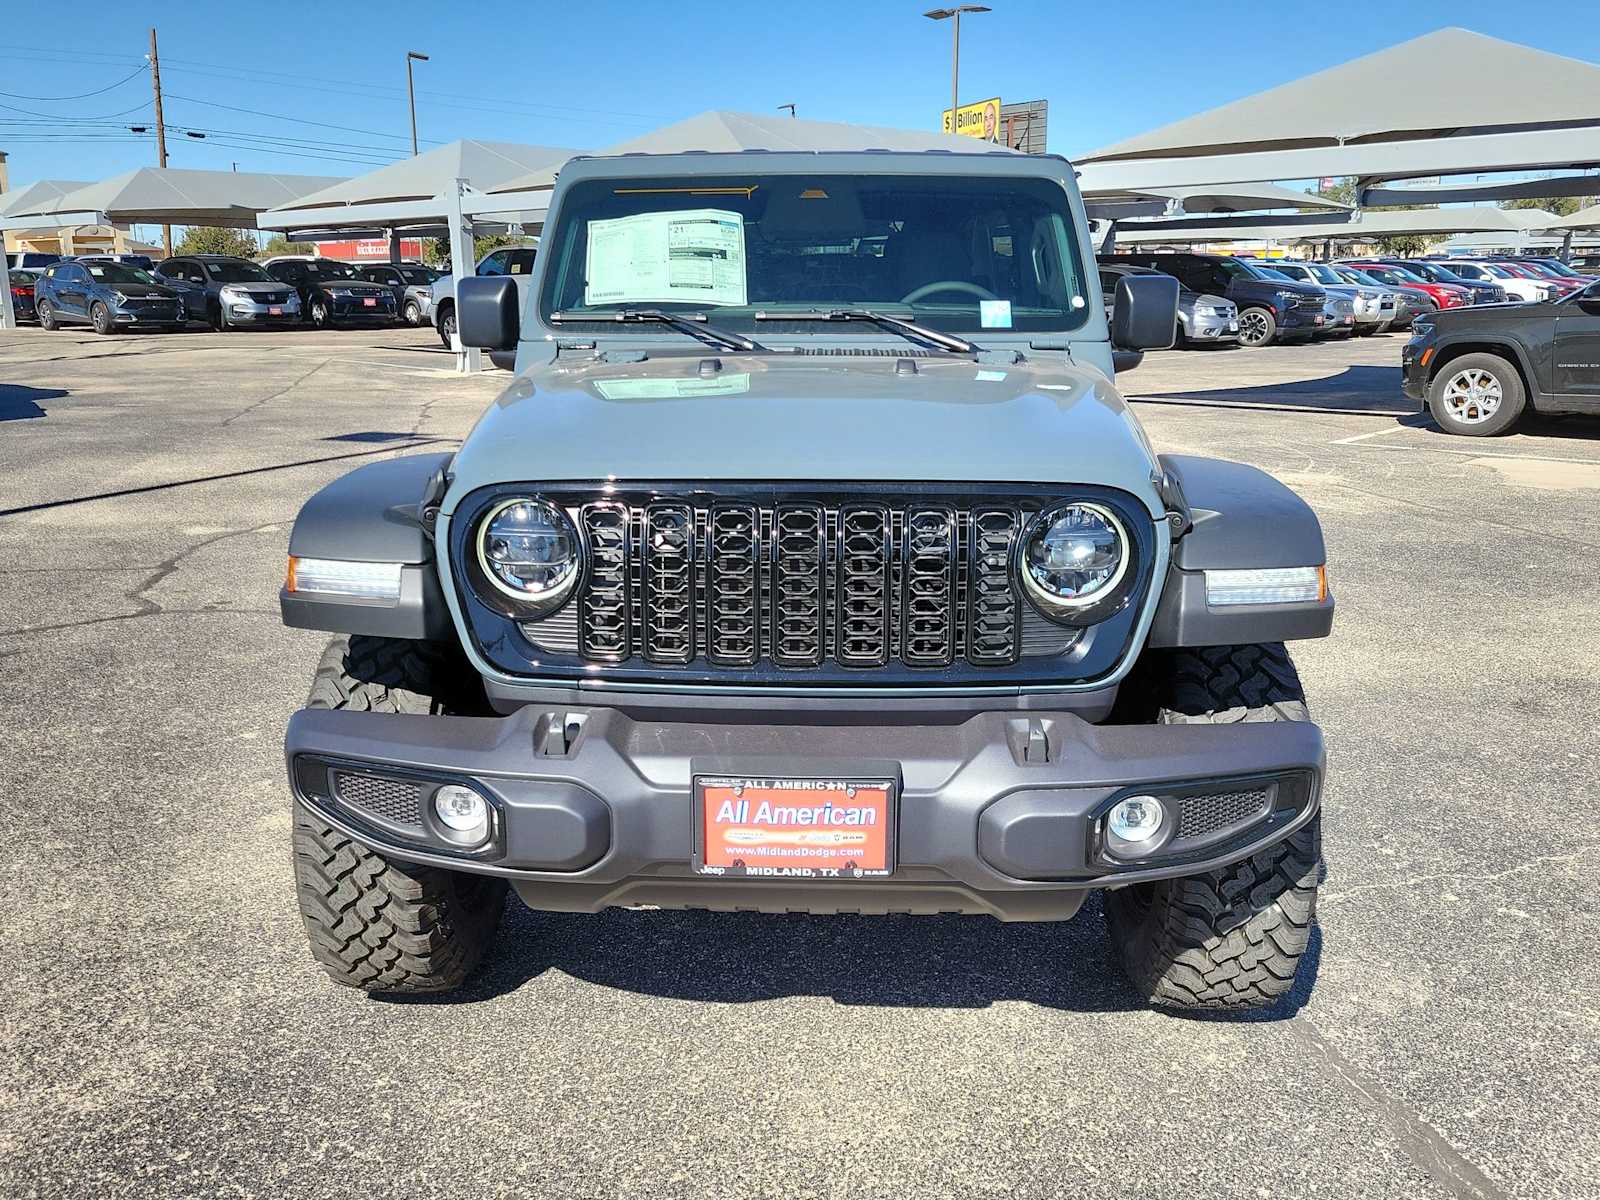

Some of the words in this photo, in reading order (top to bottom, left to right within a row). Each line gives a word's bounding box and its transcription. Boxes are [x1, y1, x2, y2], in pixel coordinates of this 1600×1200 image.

[957, 111, 983, 128] Billion
[744, 781, 769, 789] ALL
[716, 800, 750, 823] All
[753, 801, 877, 825] American
[725, 846, 865, 859] www.MidlandDodge.com
[700, 865, 726, 875] Jeep
[746, 867, 817, 877] MIDLAND,
[820, 868, 840, 877] TX
